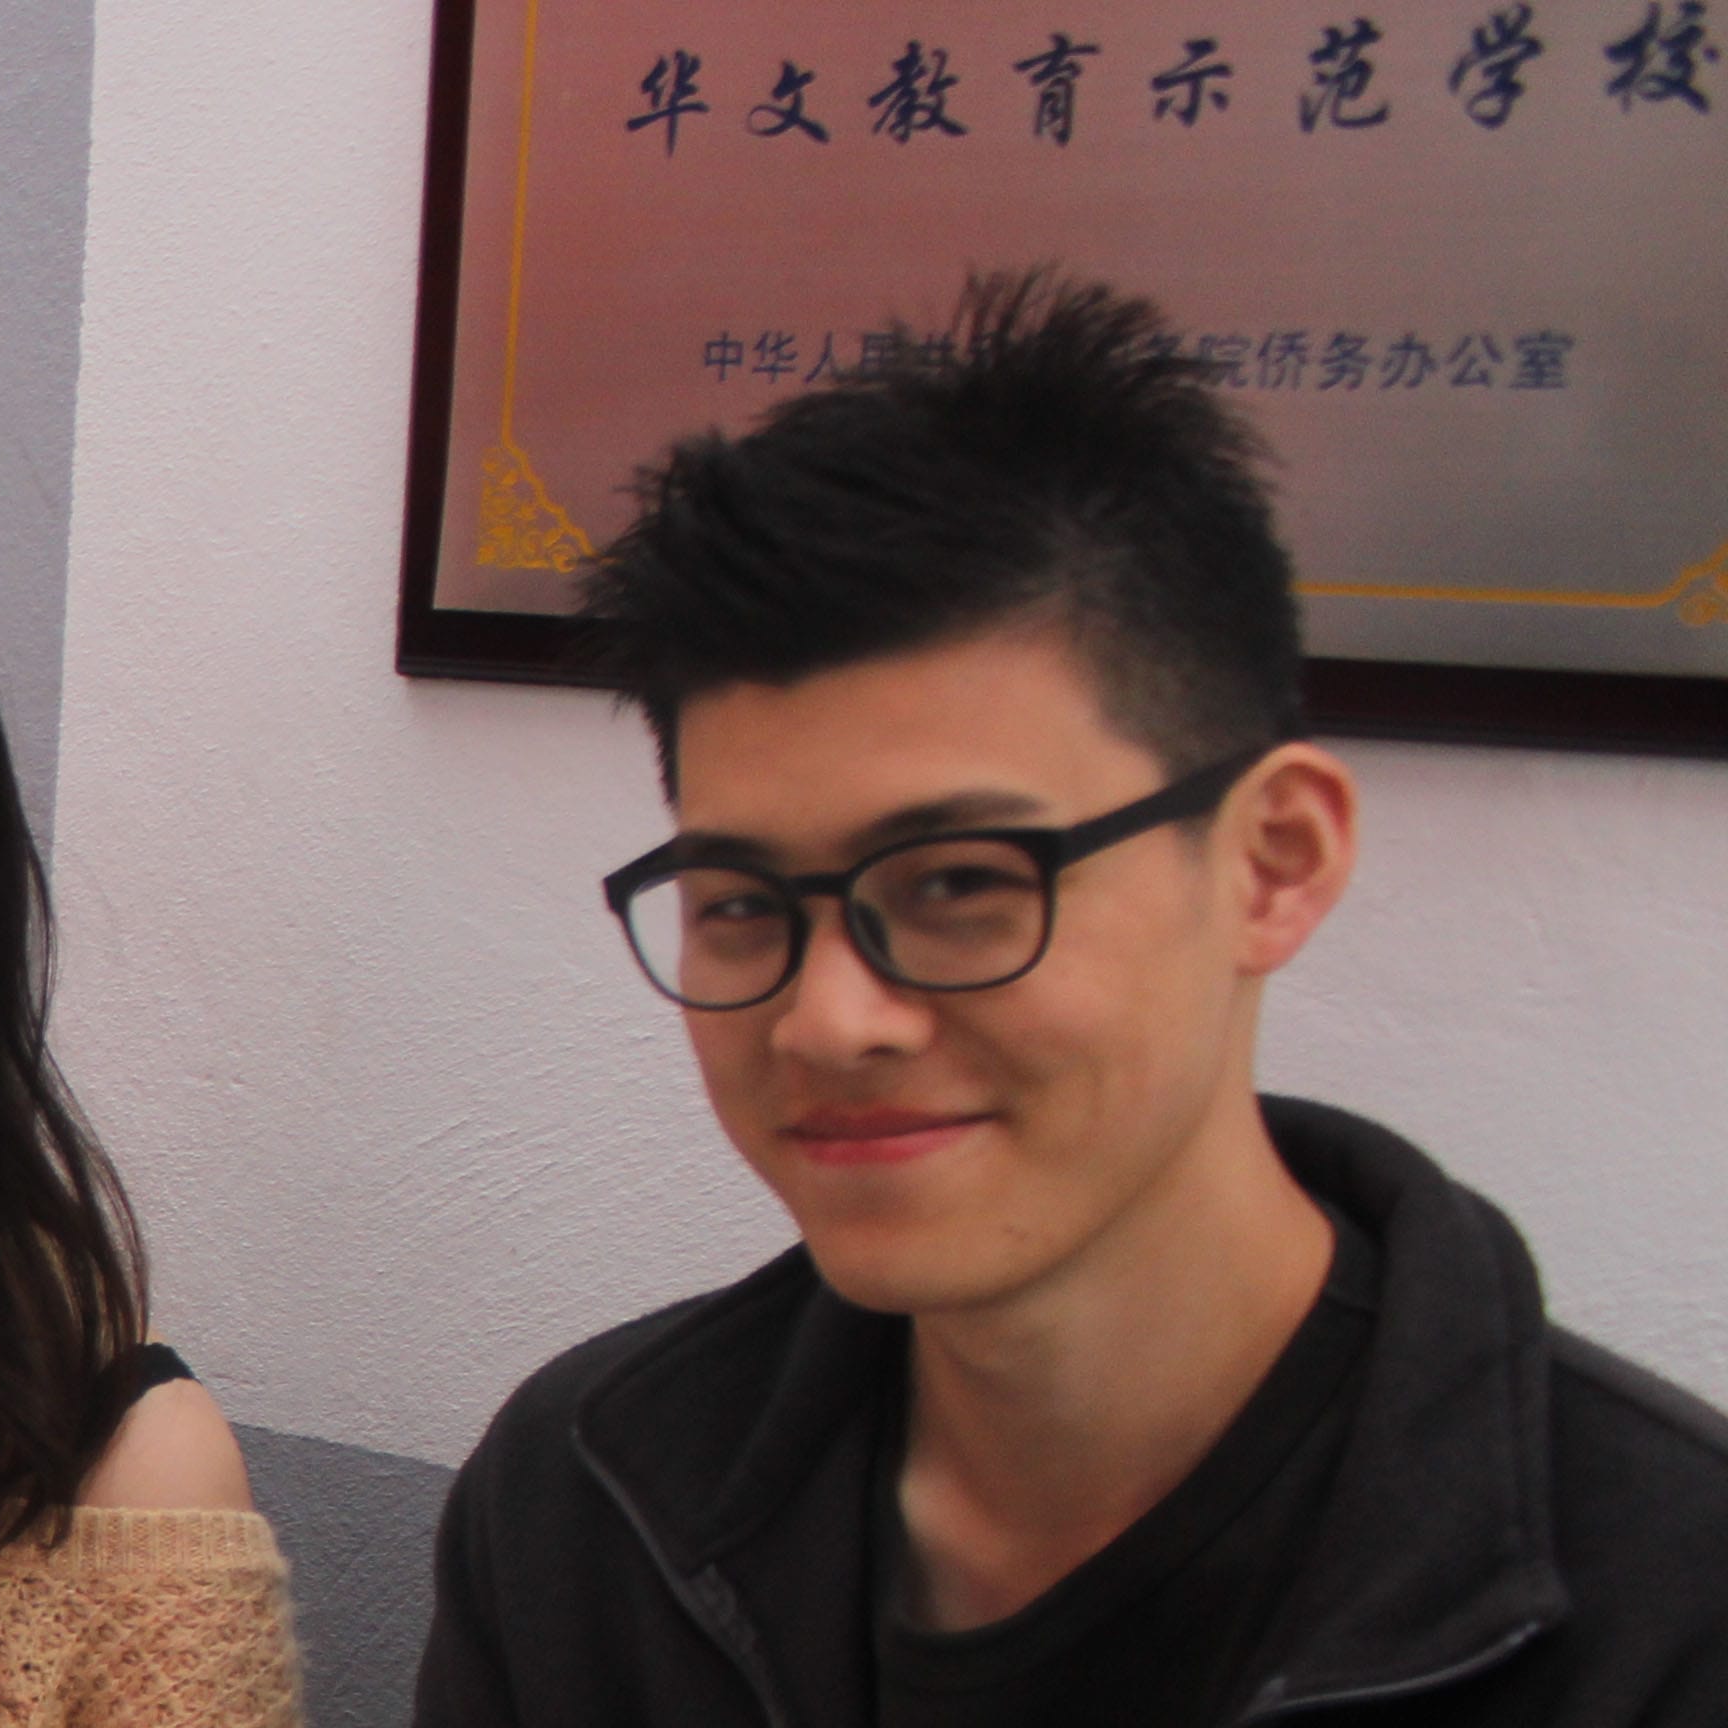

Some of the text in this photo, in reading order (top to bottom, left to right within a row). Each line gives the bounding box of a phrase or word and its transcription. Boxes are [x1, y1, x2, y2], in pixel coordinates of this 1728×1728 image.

[626, 2, 1720, 158] 华文教育示范学校
